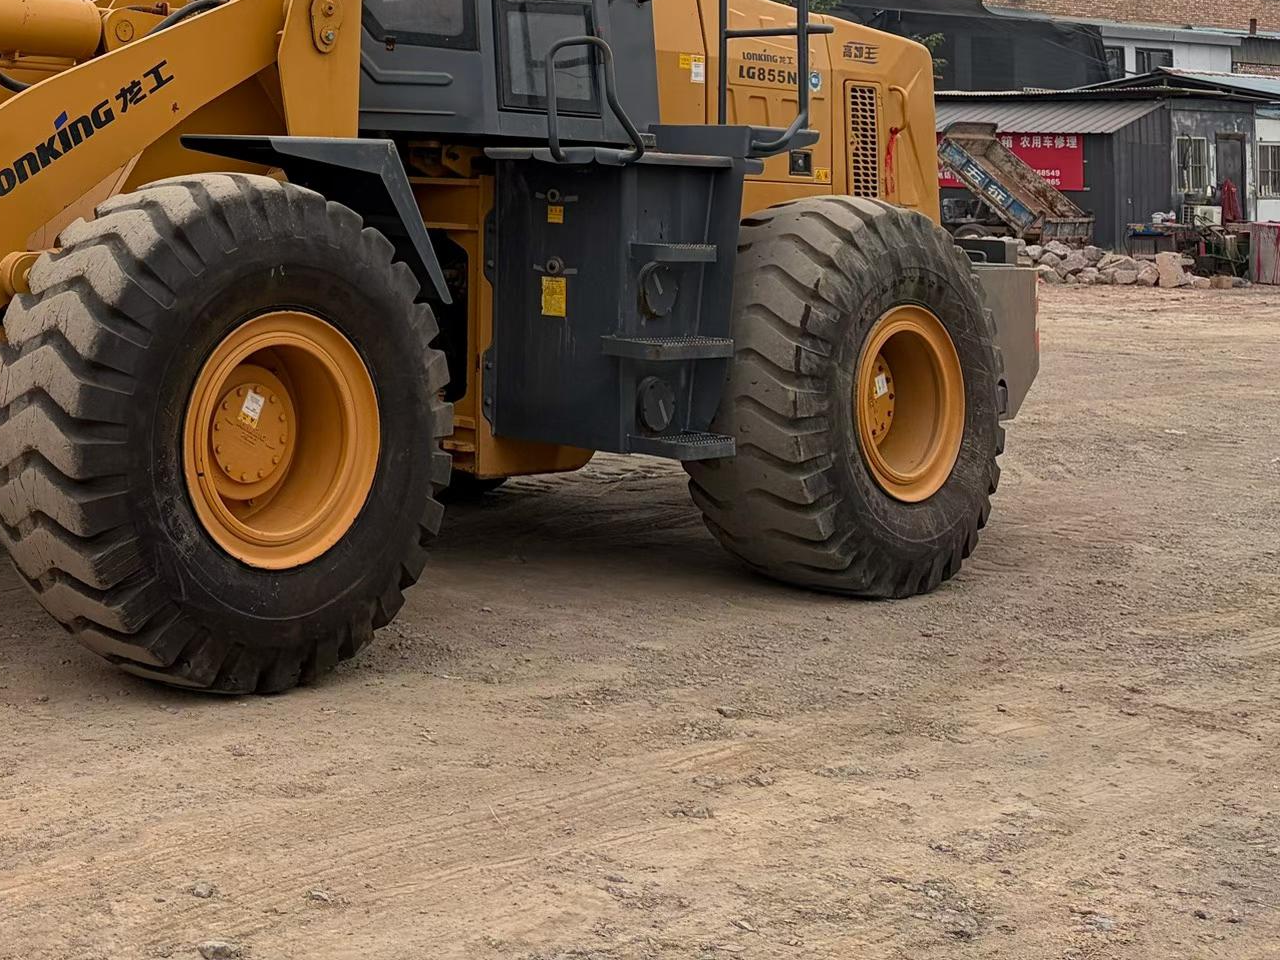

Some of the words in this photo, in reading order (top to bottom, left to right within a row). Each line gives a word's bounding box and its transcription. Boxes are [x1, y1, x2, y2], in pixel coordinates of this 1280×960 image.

[738, 65, 797, 84] LG855N
[1020, 136, 1078, 148] 农用车修理
